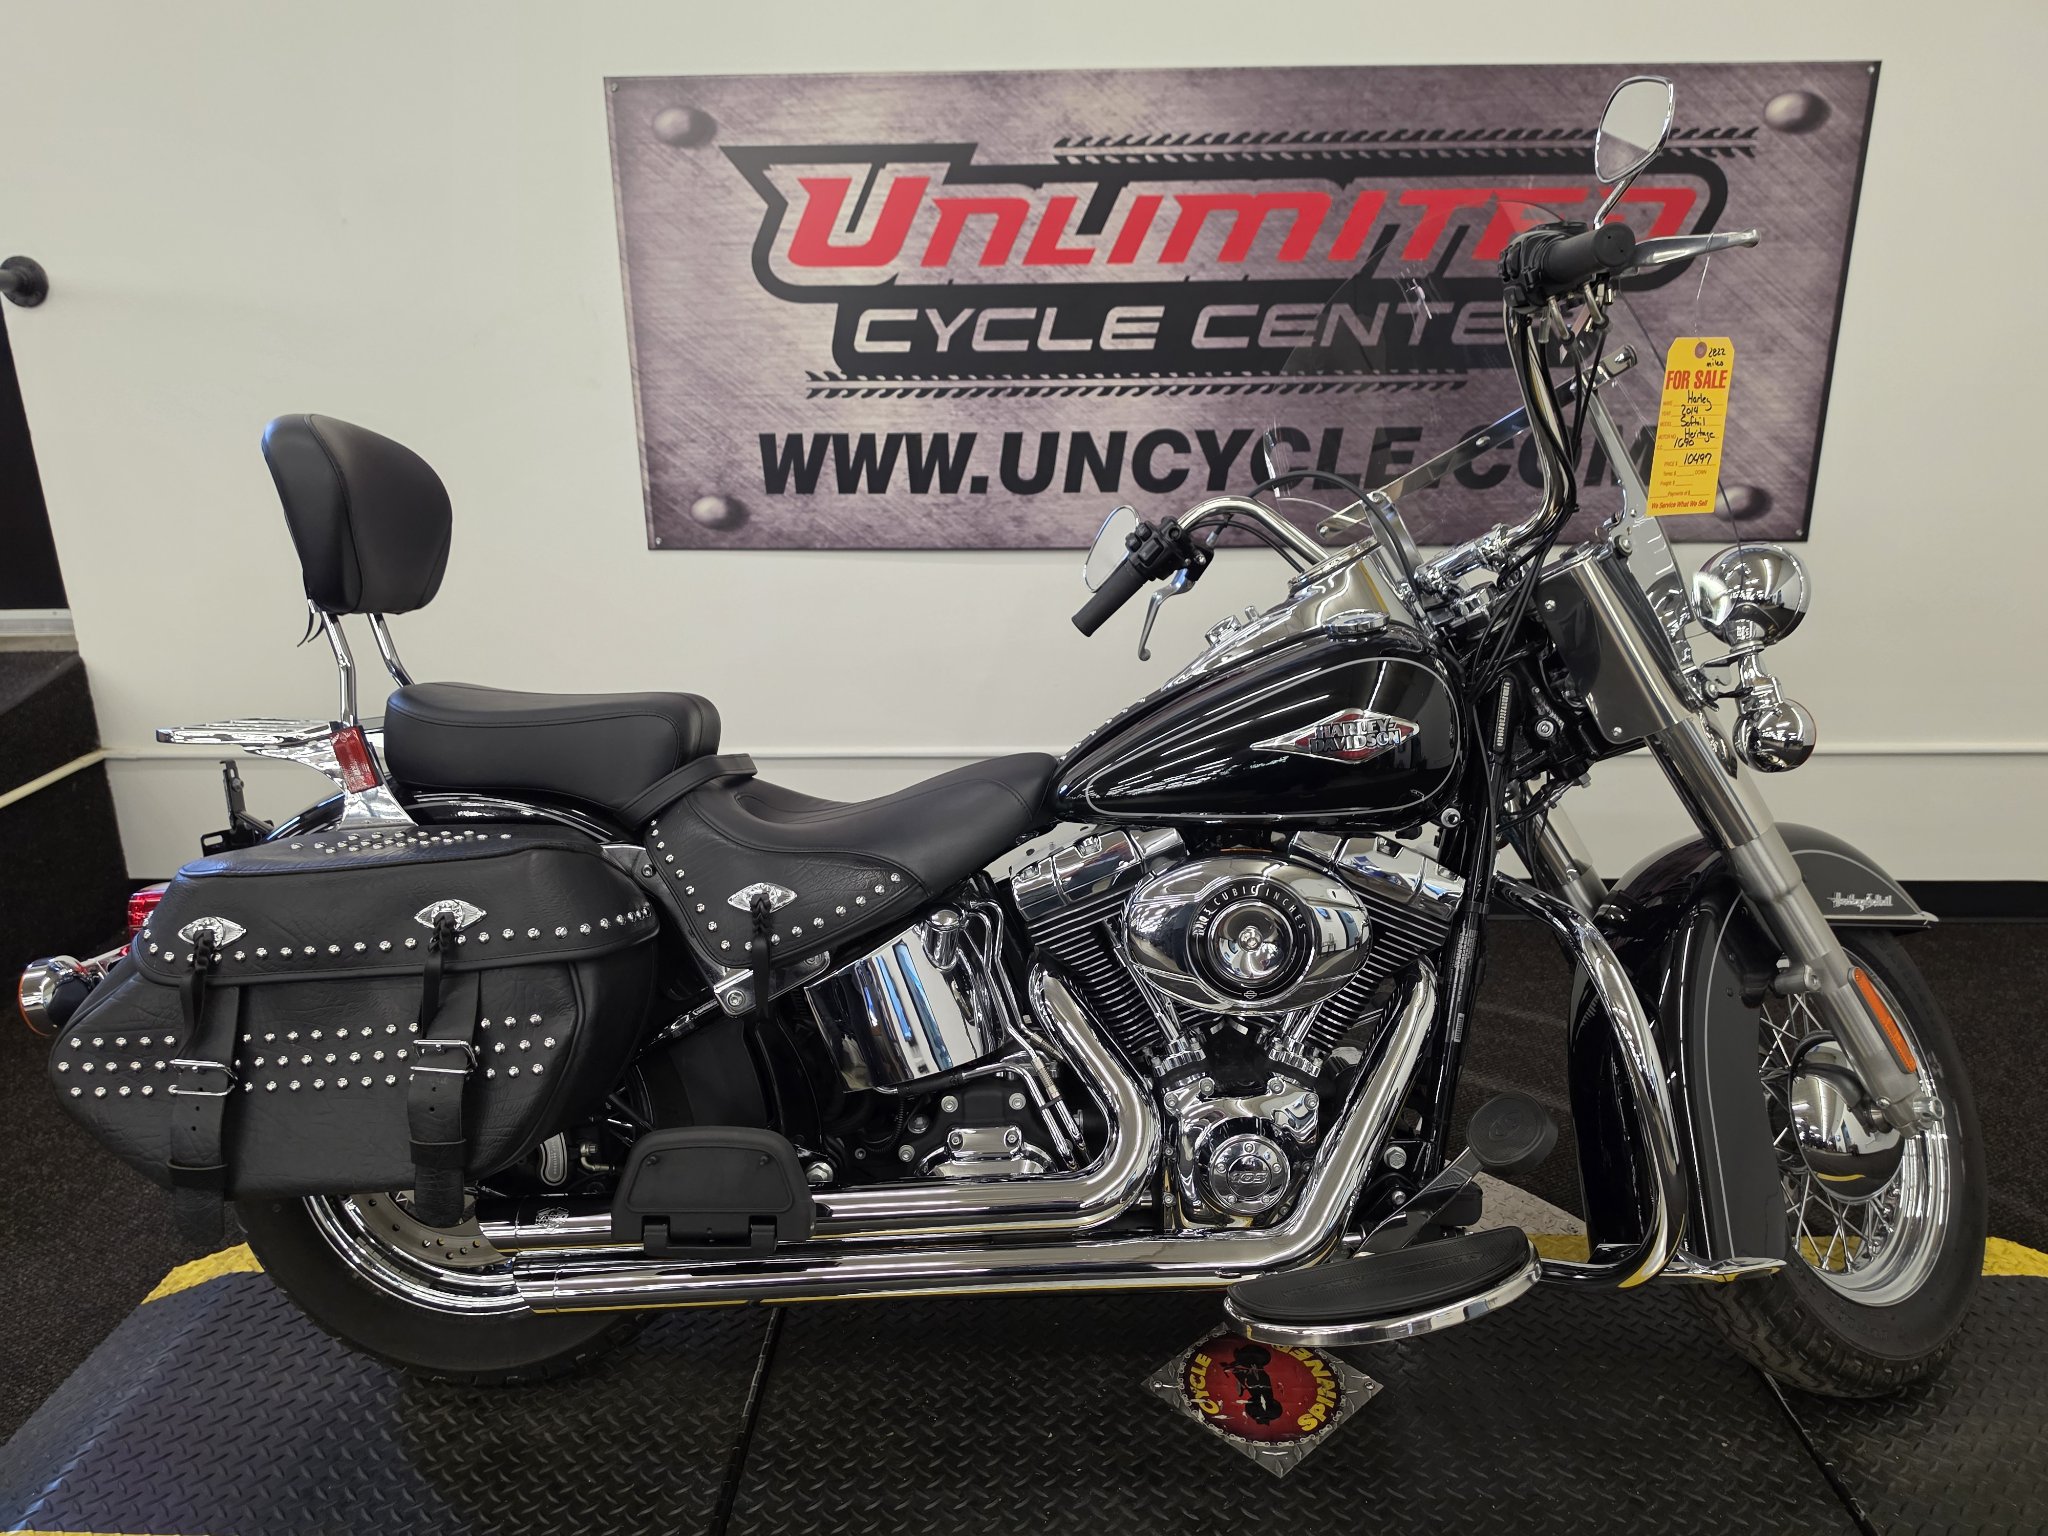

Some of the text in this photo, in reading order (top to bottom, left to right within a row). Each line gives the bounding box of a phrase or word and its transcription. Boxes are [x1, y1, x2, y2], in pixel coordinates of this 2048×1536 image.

[852, 300, 1514, 354] CYCLE CENTE
[1665, 369, 1728, 390] FOR SALE
[1680, 404, 1699, 416] 2014
[1687, 390, 1713, 412] Harley
[1673, 436, 1695, 448] 1690
[1684, 427, 1716, 443] Heritage
[1683, 452, 1713, 465] 10497
[1689, 500, 1698, 508] We
[1698, 499, 1709, 507] Sell
[1314, 718, 1397, 740] HARLEY-
[1309, 730, 1401, 753] DAVIDSON
[1213, 884, 1261, 907] CUBIC
[1264, 887, 1308, 931] INCHES
[1188, 1352, 1220, 1416] CYCLE
